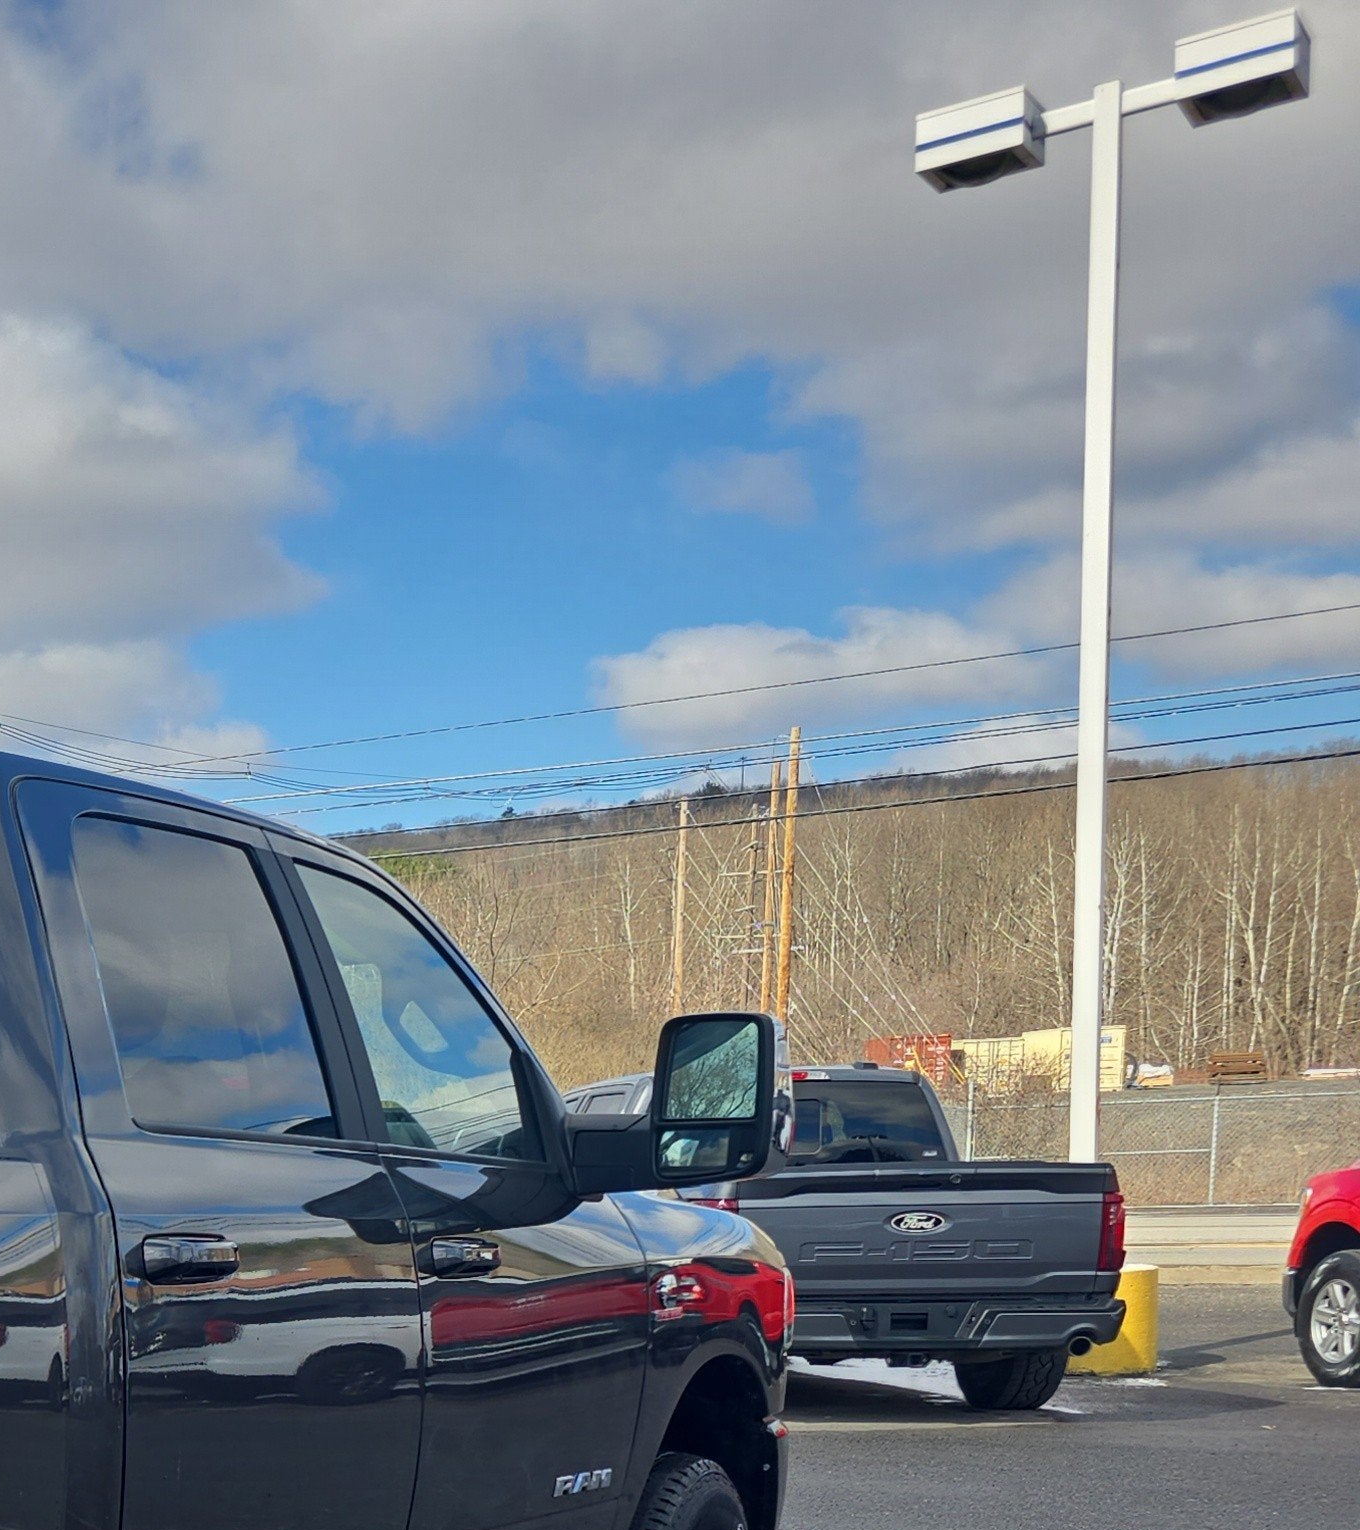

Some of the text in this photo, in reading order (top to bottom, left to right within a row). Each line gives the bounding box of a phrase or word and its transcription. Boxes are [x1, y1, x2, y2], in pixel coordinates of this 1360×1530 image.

[899, 1216, 936, 1229] Ford
[799, 1241, 1033, 1261] F-150
[553, 1468, 612, 1497] RAM
